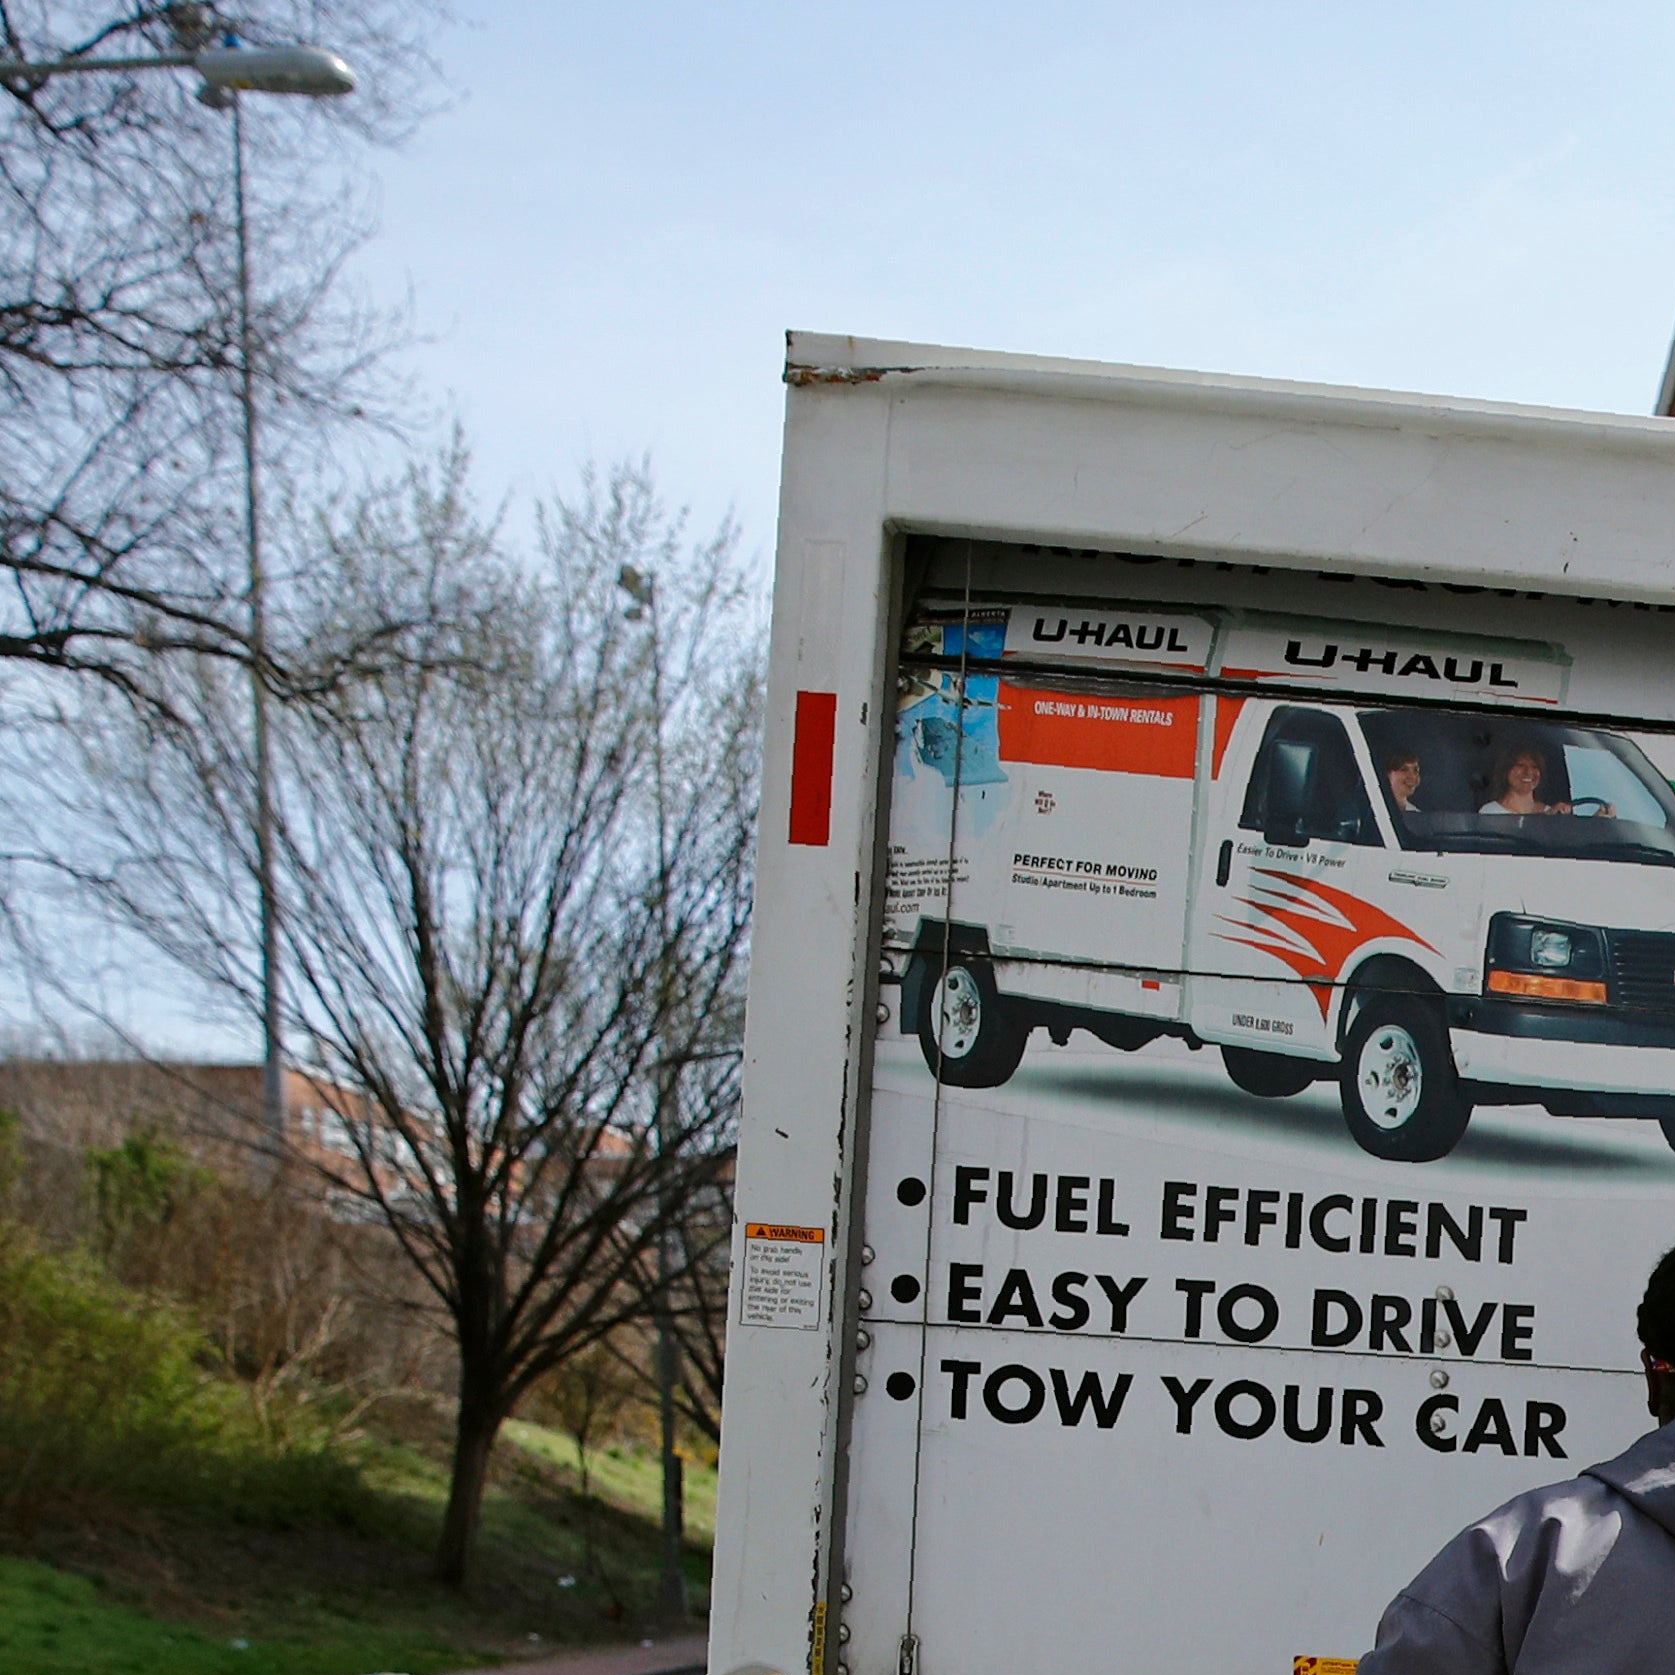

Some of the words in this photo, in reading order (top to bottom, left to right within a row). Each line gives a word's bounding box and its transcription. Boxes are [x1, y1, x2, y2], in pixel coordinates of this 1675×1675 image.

[1032, 618, 1188, 652] U-HAUL
[1284, 639, 1518, 688] U-HAUL
[1034, 701, 1077, 718] ONE-WAY
[1077, 703, 1086, 718] &
[1087, 705, 1129, 722] IN-TOWN
[1129, 709, 1174, 727] RENTALS
[1013, 853, 1074, 872] PERFECT
[1075, 860, 1102, 876] FOR
[1105, 864, 1158, 881] MOVING
[1237, 843, 1263, 855] Easier
[1265, 847, 1275, 858] To
[1276, 849, 1299, 861] Drive
[1306, 853, 1318, 864] V8
[1319, 856, 1346, 868] Power
[1089, 883, 1101, 894] Up
[1102, 884, 1112, 894] to
[1119, 885, 1157, 899] Bedroom
[954, 1166, 1128, 1236] FUEL
[1161, 1182, 1527, 1264] EFFICIENT
[769, 1227, 815, 1241] WARNING
[947, 1262, 1148, 1334] EASY
[1176, 1278, 1279, 1344] TO
[1312, 1287, 1535, 1360] DRIVE
[941, 1360, 1133, 1428] TOW
[1161, 1376, 1385, 1448] YOUR
[1416, 1394, 1568, 1459] CAR
